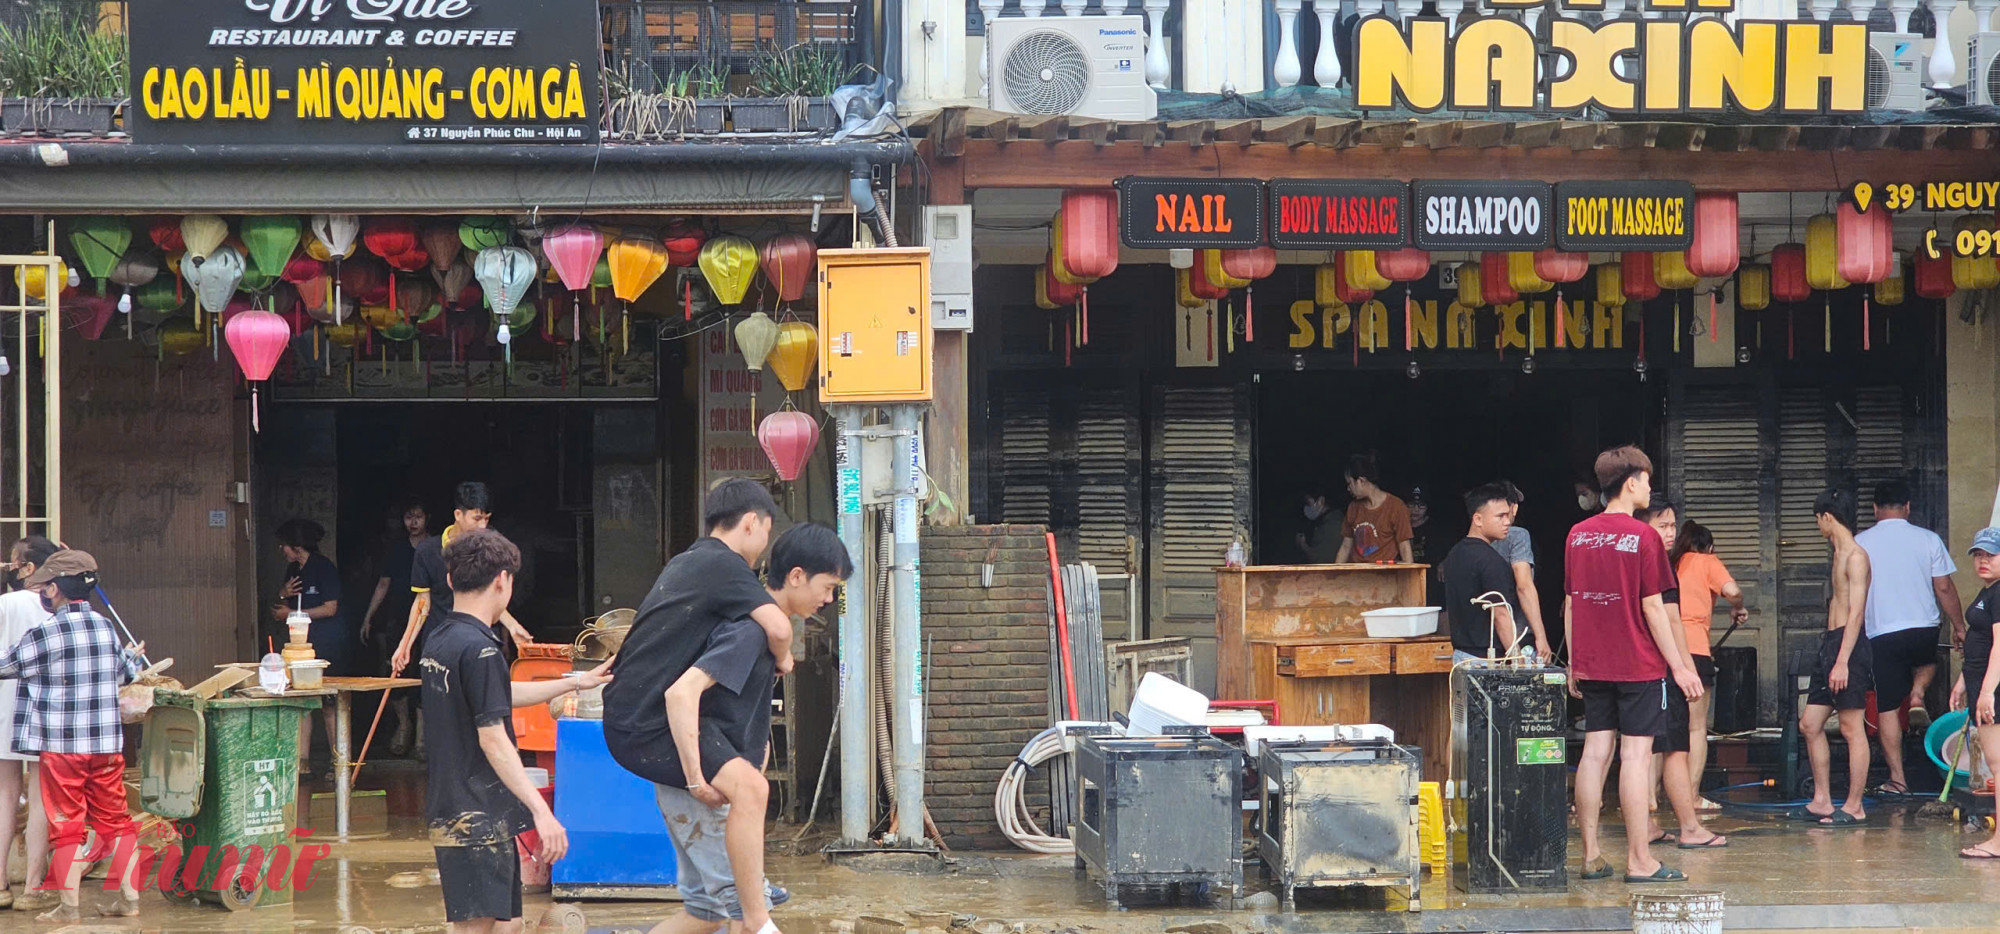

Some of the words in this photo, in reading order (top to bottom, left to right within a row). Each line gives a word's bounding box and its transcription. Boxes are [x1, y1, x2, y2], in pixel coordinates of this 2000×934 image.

[208, 29, 381, 46] RESTAURANT
[385, 29, 405, 46] &
[414, 29, 517, 46] COFFEE
[1099, 28, 1137, 36] Panasonic
[1357, 20, 1533, 109] NA
[1551, 20, 1866, 111] XINH
[142, 66, 208, 120] CAO
[213, 56, 271, 120] LẦU
[297, 60, 332, 119] MÌ
[335, 56, 445, 121] QUẢNG
[470, 65, 536, 120] CƠM
[540, 61, 586, 120] GÀ
[423, 127, 438, 138] 37
[441, 126, 481, 140] Nguyễn
[484, 126, 511, 138] Phúc
[514, 127, 535, 138] Chu
[546, 126, 565, 140] Hội
[567, 127, 582, 138] An
[1155, 194, 1233, 233] NAIL
[1280, 196, 1322, 234] BODY
[1326, 196, 1398, 234] MASSAGE
[1885, 183, 1915, 209] 39
[1425, 196, 1541, 236] SHAMPOO
[1567, 197, 1609, 236] FOOT
[1612, 197, 1684, 236] MASSAGE
[1289, 300, 1390, 348] SPA
[1495, 300, 1624, 348] XINH
[259, 762, 270, 770] HT
